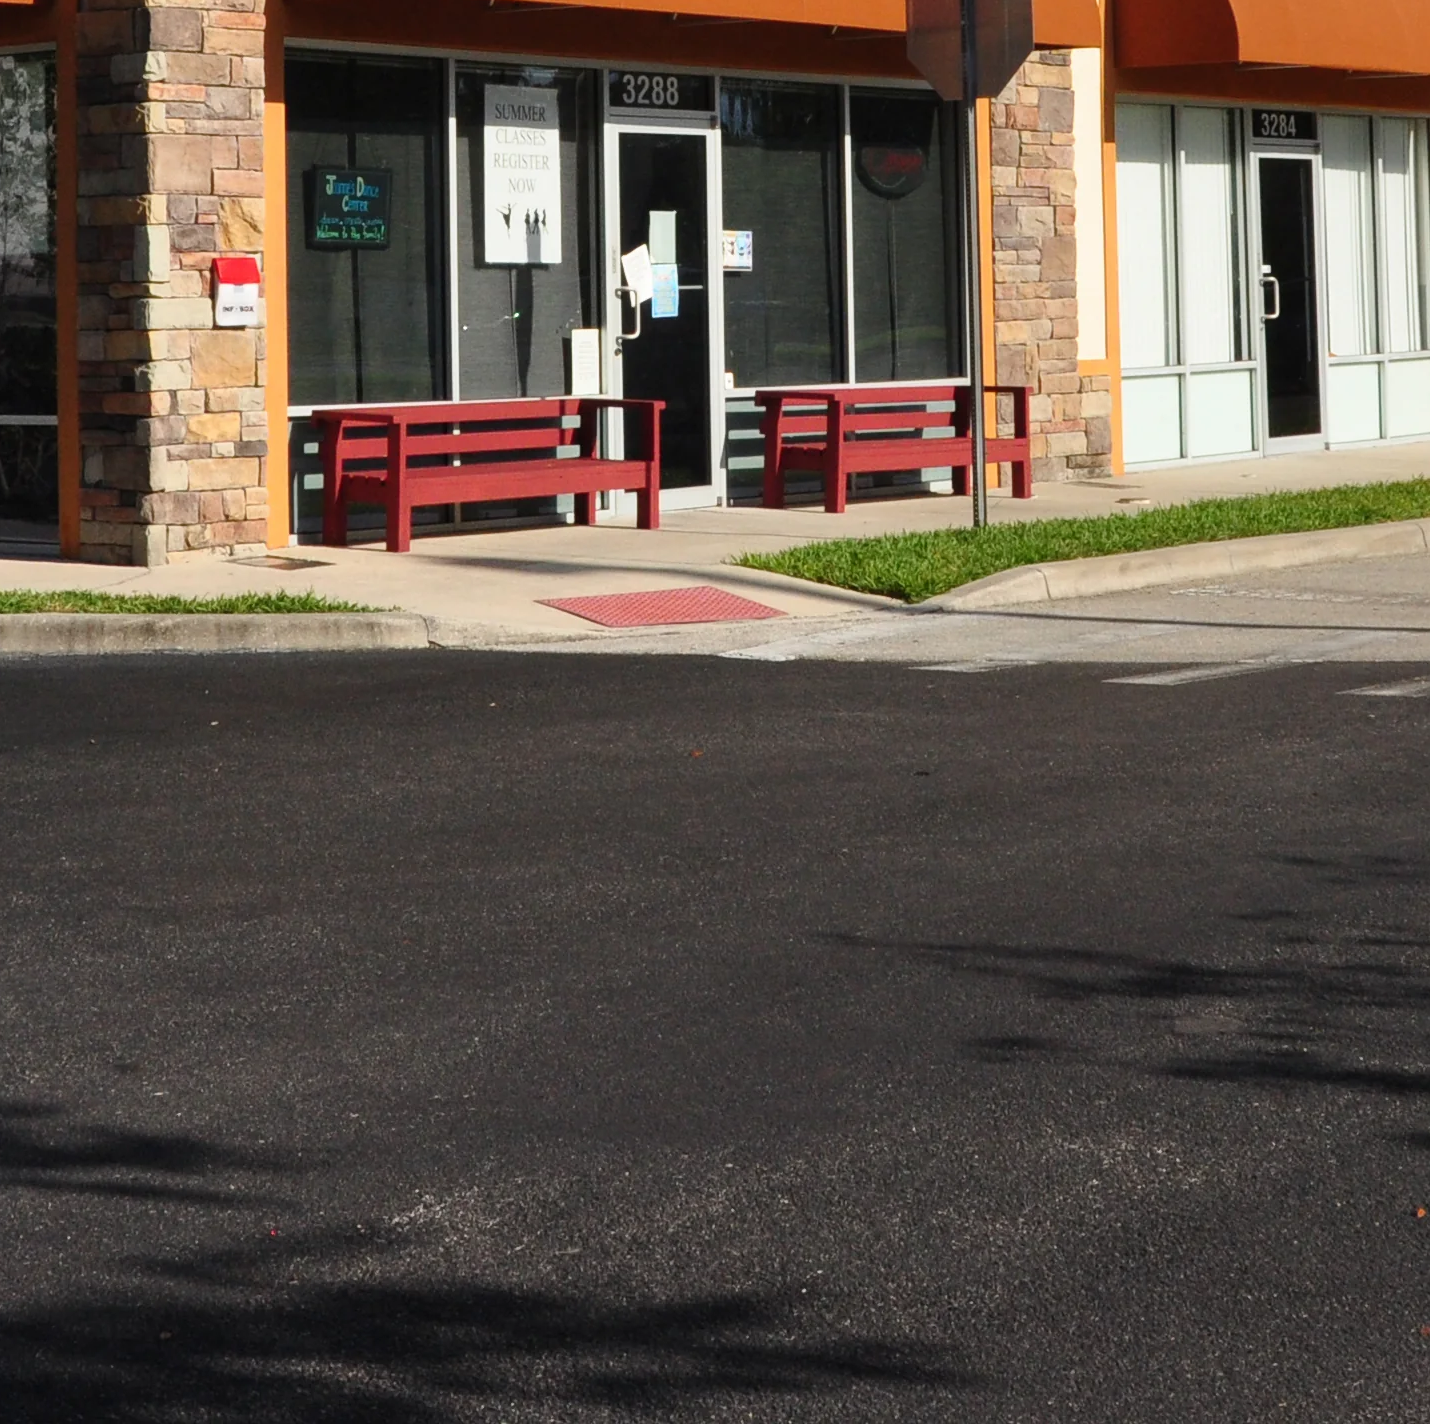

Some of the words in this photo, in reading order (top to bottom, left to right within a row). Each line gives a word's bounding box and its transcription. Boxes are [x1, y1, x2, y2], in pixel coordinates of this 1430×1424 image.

[622, 74, 680, 106] 3288
[494, 103, 547, 123] SUMMER
[1261, 112, 1297, 137] 3284
[495, 128, 547, 146] CLASSES
[493, 152, 550, 171] REGISTER
[508, 178, 536, 195] NOW
